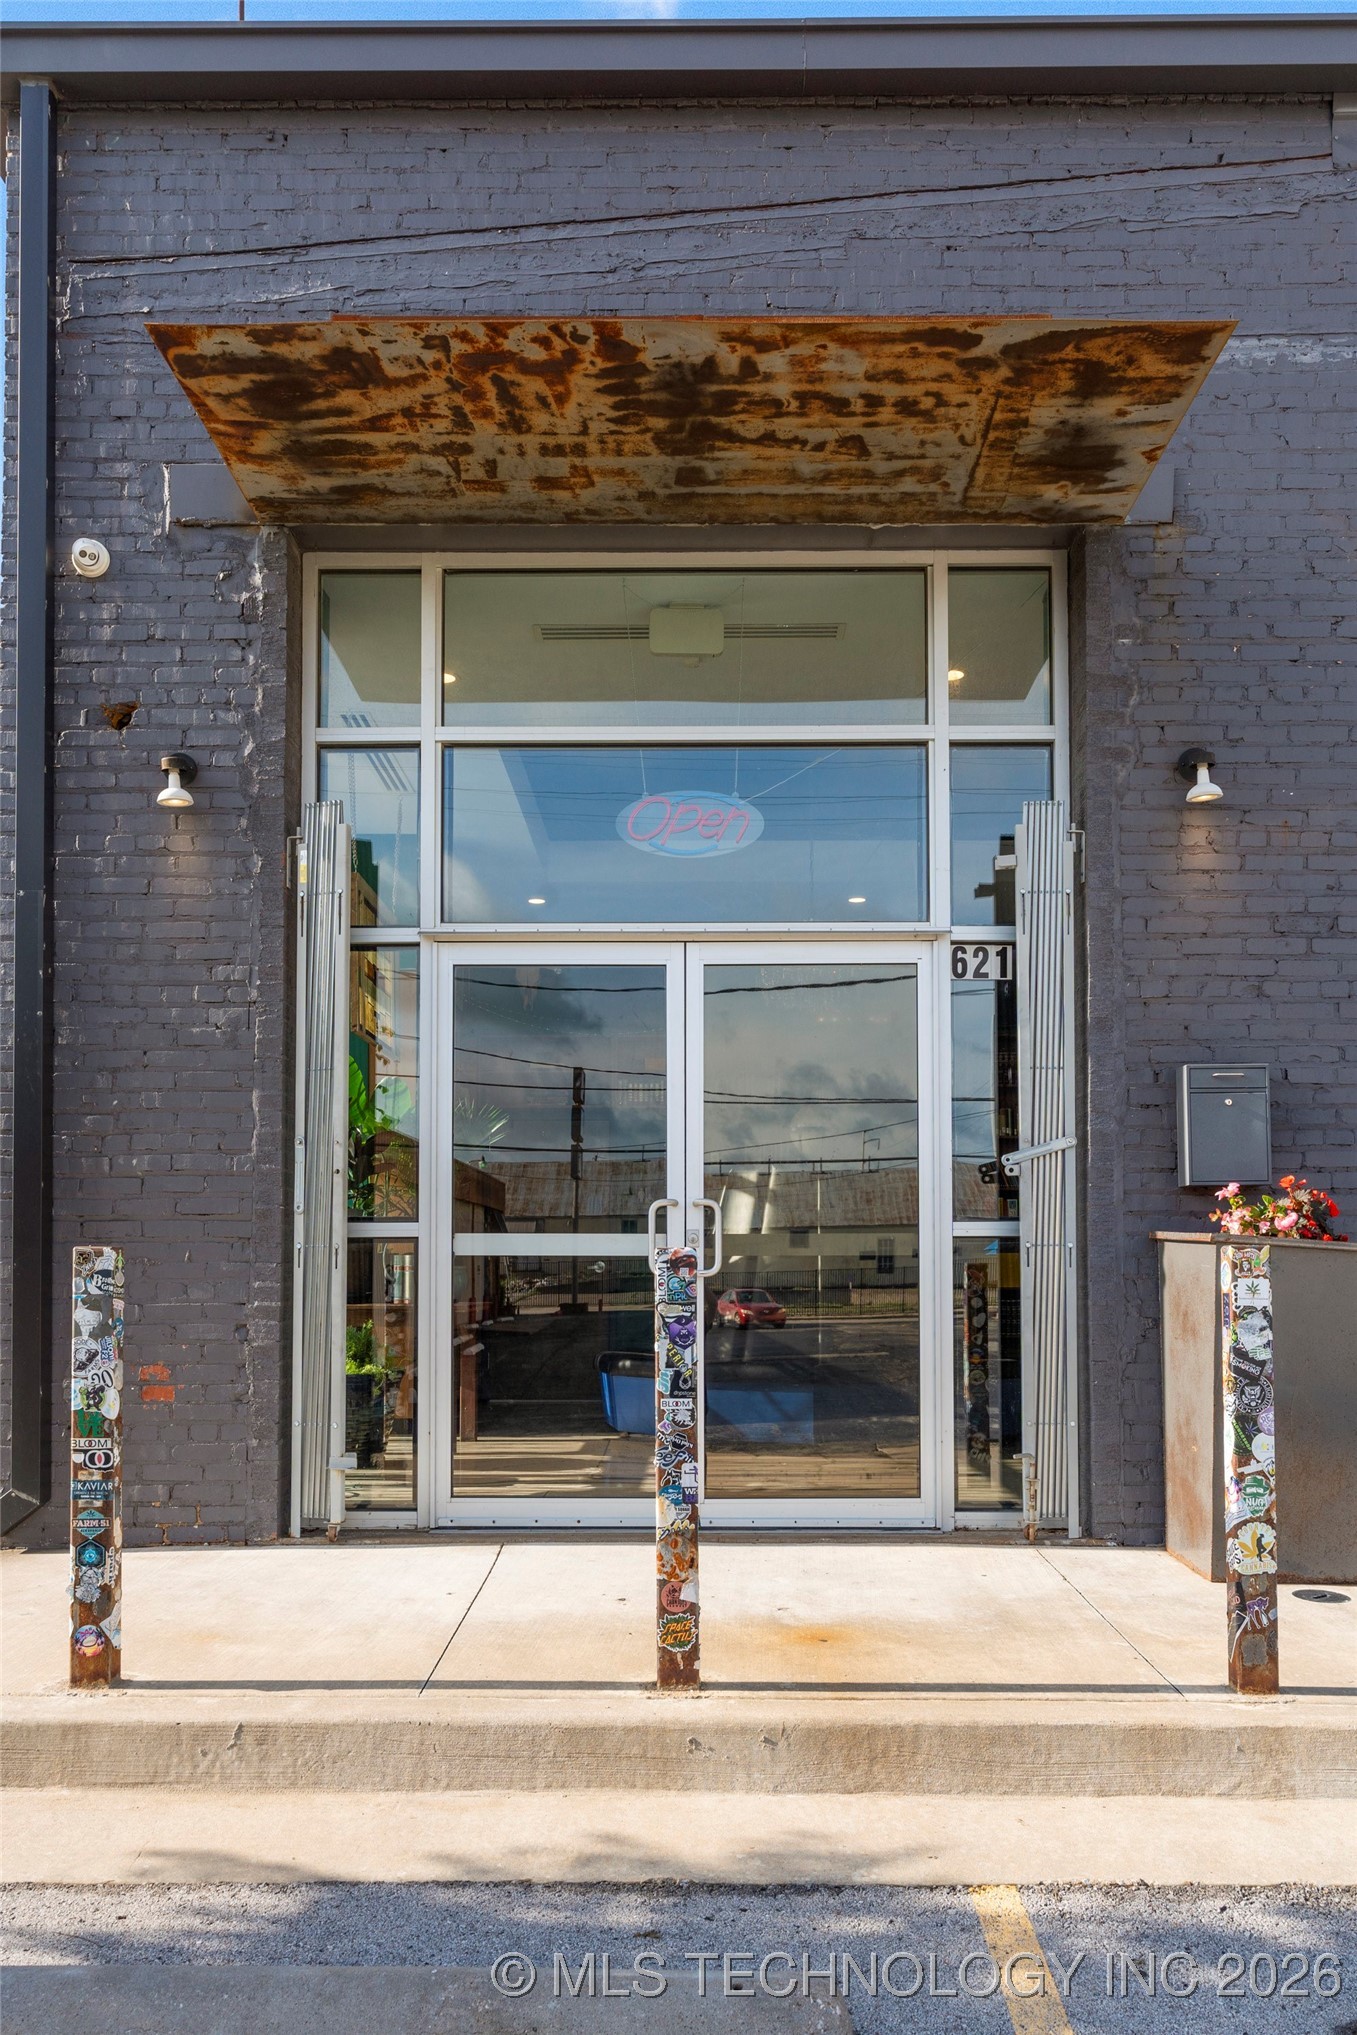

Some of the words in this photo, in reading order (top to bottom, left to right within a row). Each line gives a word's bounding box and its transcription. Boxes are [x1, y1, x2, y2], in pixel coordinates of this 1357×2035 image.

[628, 796, 750, 846] Open
[951, 945, 1009, 979] 621
[667, 1343, 693, 1378] PERIR
[662, 1400, 691, 1408] BLOOM
[662, 1619, 692, 1634] SPACE
